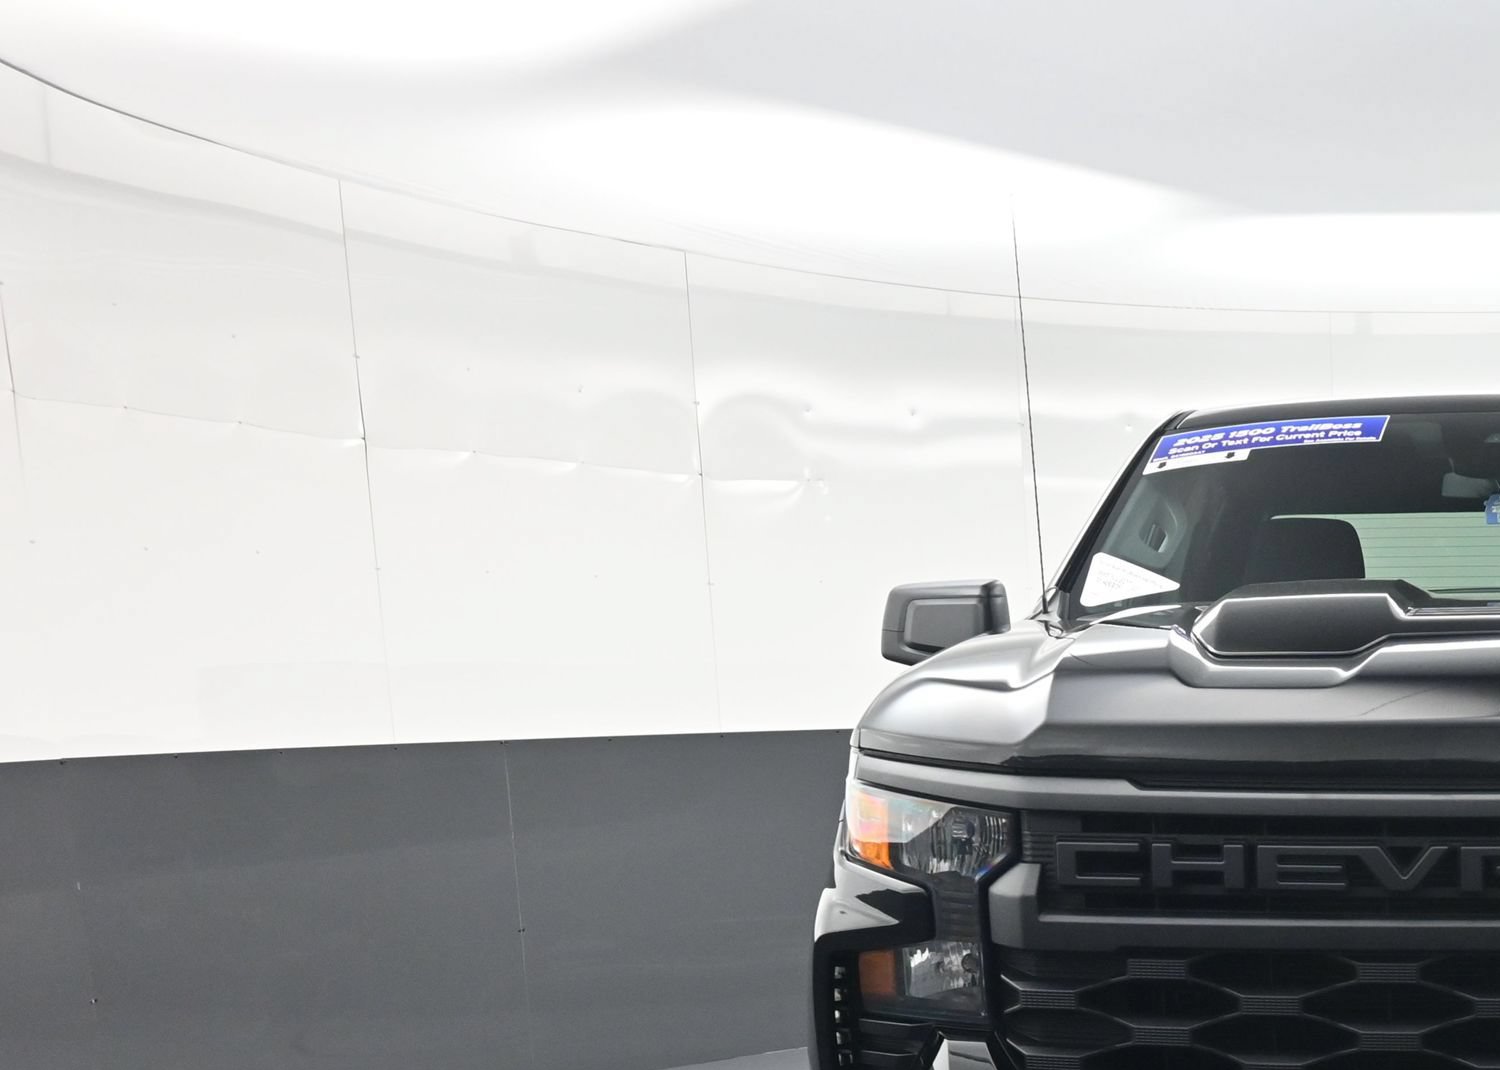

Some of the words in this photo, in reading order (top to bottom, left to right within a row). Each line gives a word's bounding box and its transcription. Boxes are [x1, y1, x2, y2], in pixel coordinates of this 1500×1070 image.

[1168, 445, 1200, 455] Scan
[1201, 442, 1218, 450] Or
[1221, 437, 1249, 447] Text
[1252, 435, 1274, 444] For
[1275, 431, 1326, 441] Current
[1328, 429, 1363, 437] Price
[1172, 432, 1226, 447] 2025
[1228, 427, 1276, 439] 1500
